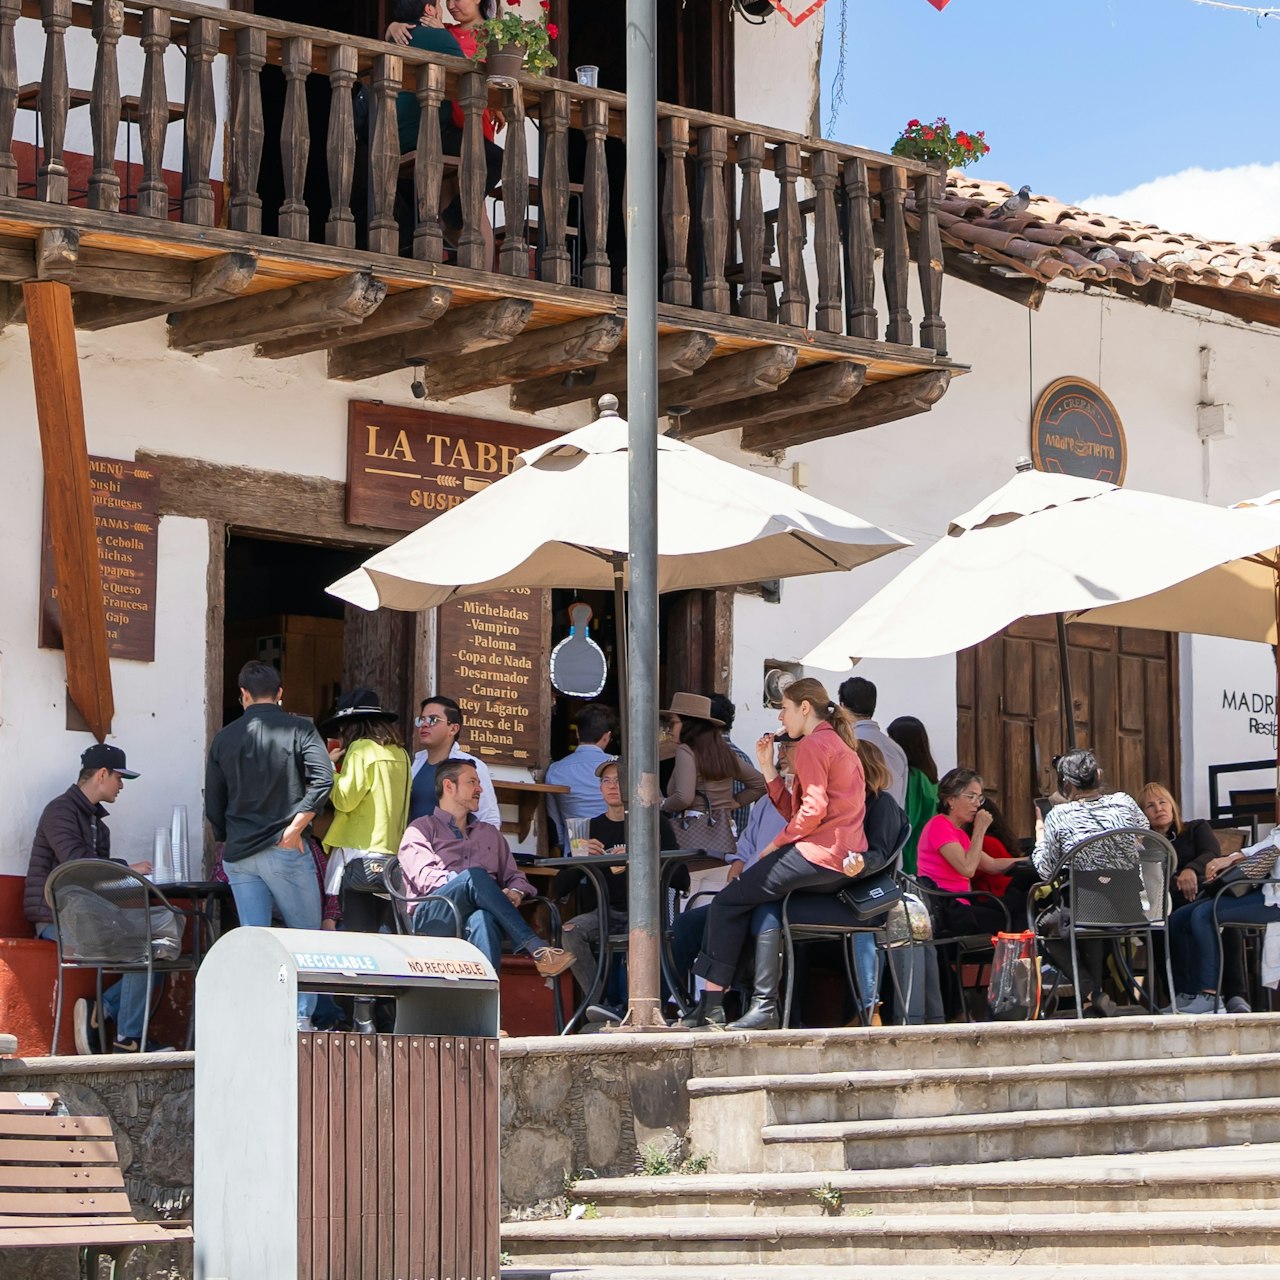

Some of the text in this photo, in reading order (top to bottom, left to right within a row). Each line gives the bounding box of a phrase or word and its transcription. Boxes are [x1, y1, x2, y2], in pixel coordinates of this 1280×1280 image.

[365, 425, 530, 476] LA TABE
[89, 461, 123, 475] MENÚ
[90, 478, 121, 493] Sushi
[410, 489, 469, 511] SUSH
[93, 516, 129, 530] TANAS
[106, 535, 145, 550] Cebolla
[97, 547, 134, 563] hichas
[110, 582, 141, 596] Queso
[103, 595, 149, 611] Francesa
[457, 601, 529, 621] -Micheladas
[106, 611, 130, 626] Gajo
[466, 619, 520, 636] -Vampiro
[469, 634, 517, 651] -Paloma
[452, 649, 532, 669] -Copa de Nada
[455, 665, 529, 685] -Desarmador
[466, 683, 518, 699] -Canario
[459, 697, 529, 717] Rey Lagarto
[462, 714, 524, 732] Luces de la
[470, 729, 513, 745] Habana
[295, 953, 376, 970] RECICLABLE
[408, 961, 485, 976] NO RECICLABLE
